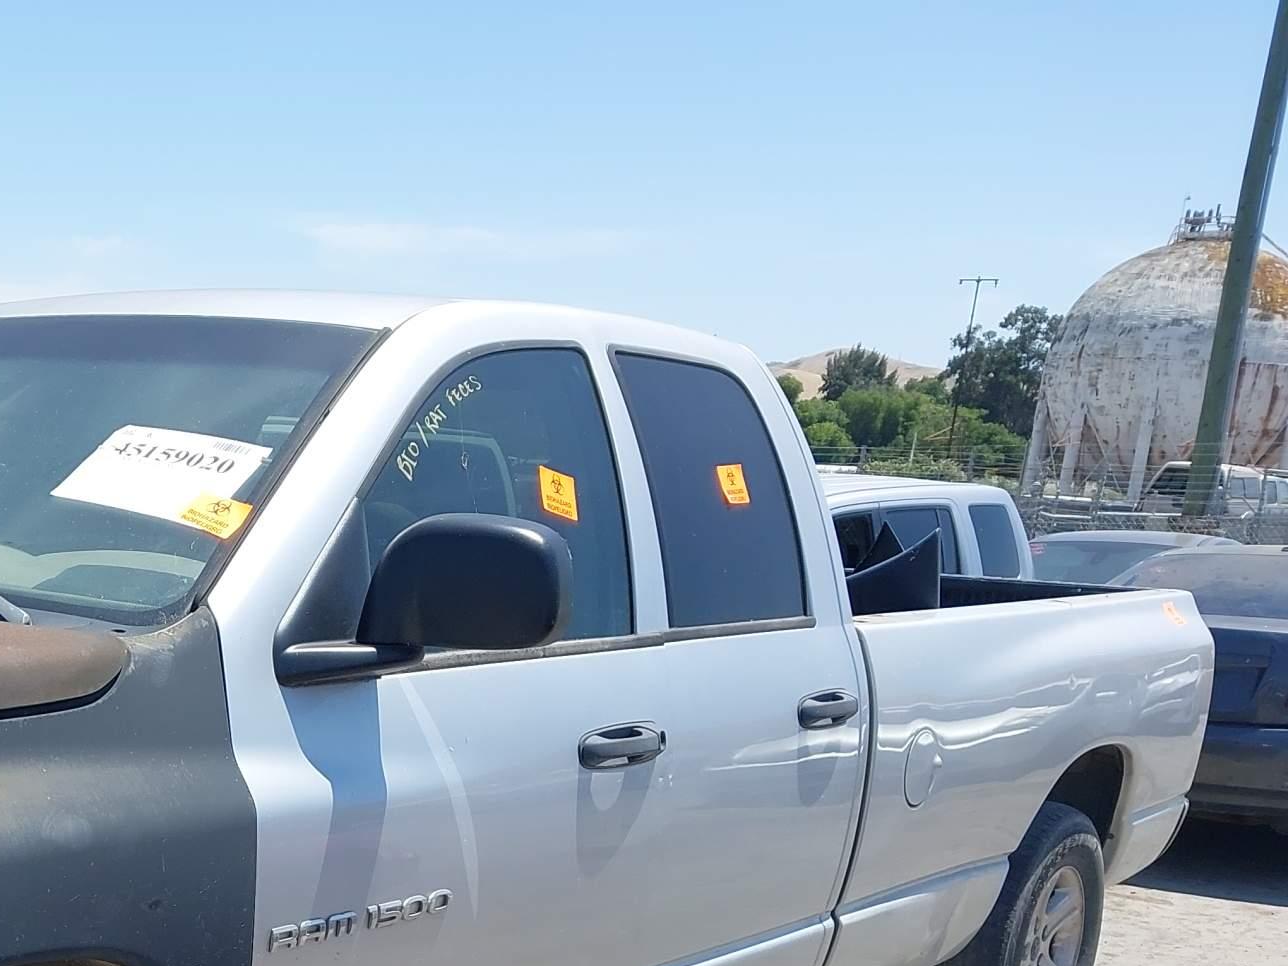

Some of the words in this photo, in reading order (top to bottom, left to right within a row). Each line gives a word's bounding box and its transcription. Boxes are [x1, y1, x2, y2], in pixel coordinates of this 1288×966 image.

[114, 442, 235, 474] 45159020
[396, 441, 420, 481] BIO
[268, 910, 358, 953] RAM
[367, 888, 454, 930] 1500
